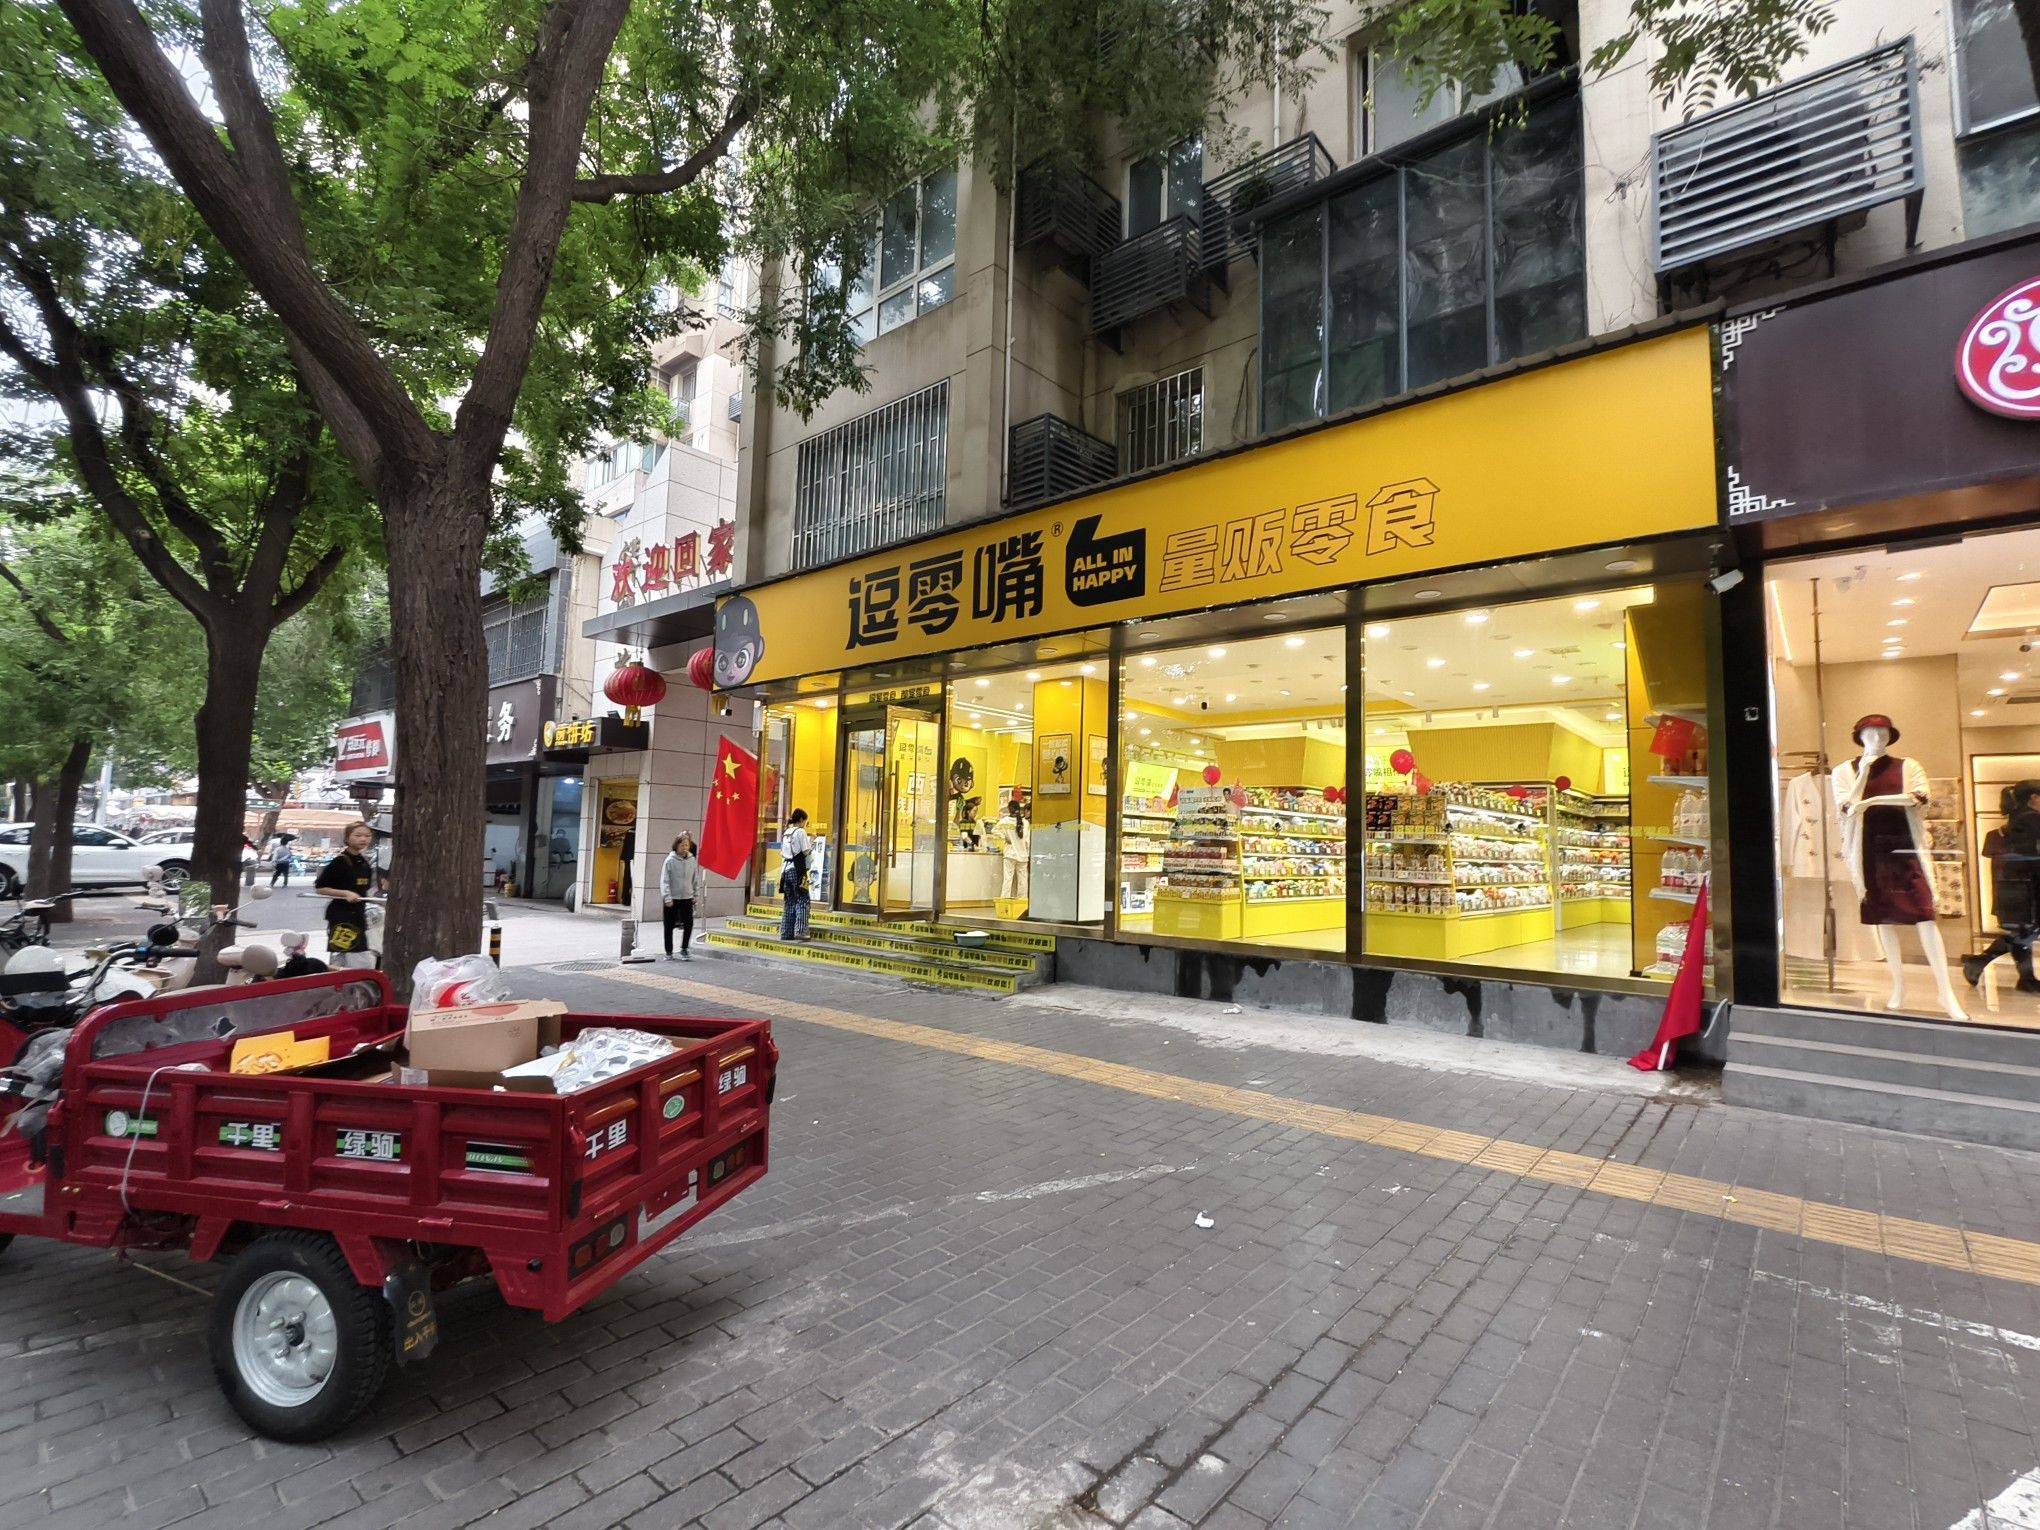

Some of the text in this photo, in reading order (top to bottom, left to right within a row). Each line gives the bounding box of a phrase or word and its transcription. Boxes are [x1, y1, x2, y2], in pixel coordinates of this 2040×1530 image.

[611, 517, 735, 603] 欢迎回家
[1072, 545, 1134, 573] ALL IN
[1159, 477, 1441, 593] 量贩零食
[845, 529, 1045, 651] 逗零嘴
[1072, 564, 1138, 592] HAPPY
[487, 701, 515, 743] 务
[227, 1122, 394, 1159] 千里 绿驹
[584, 1064, 748, 1160] 千里 绿驹
